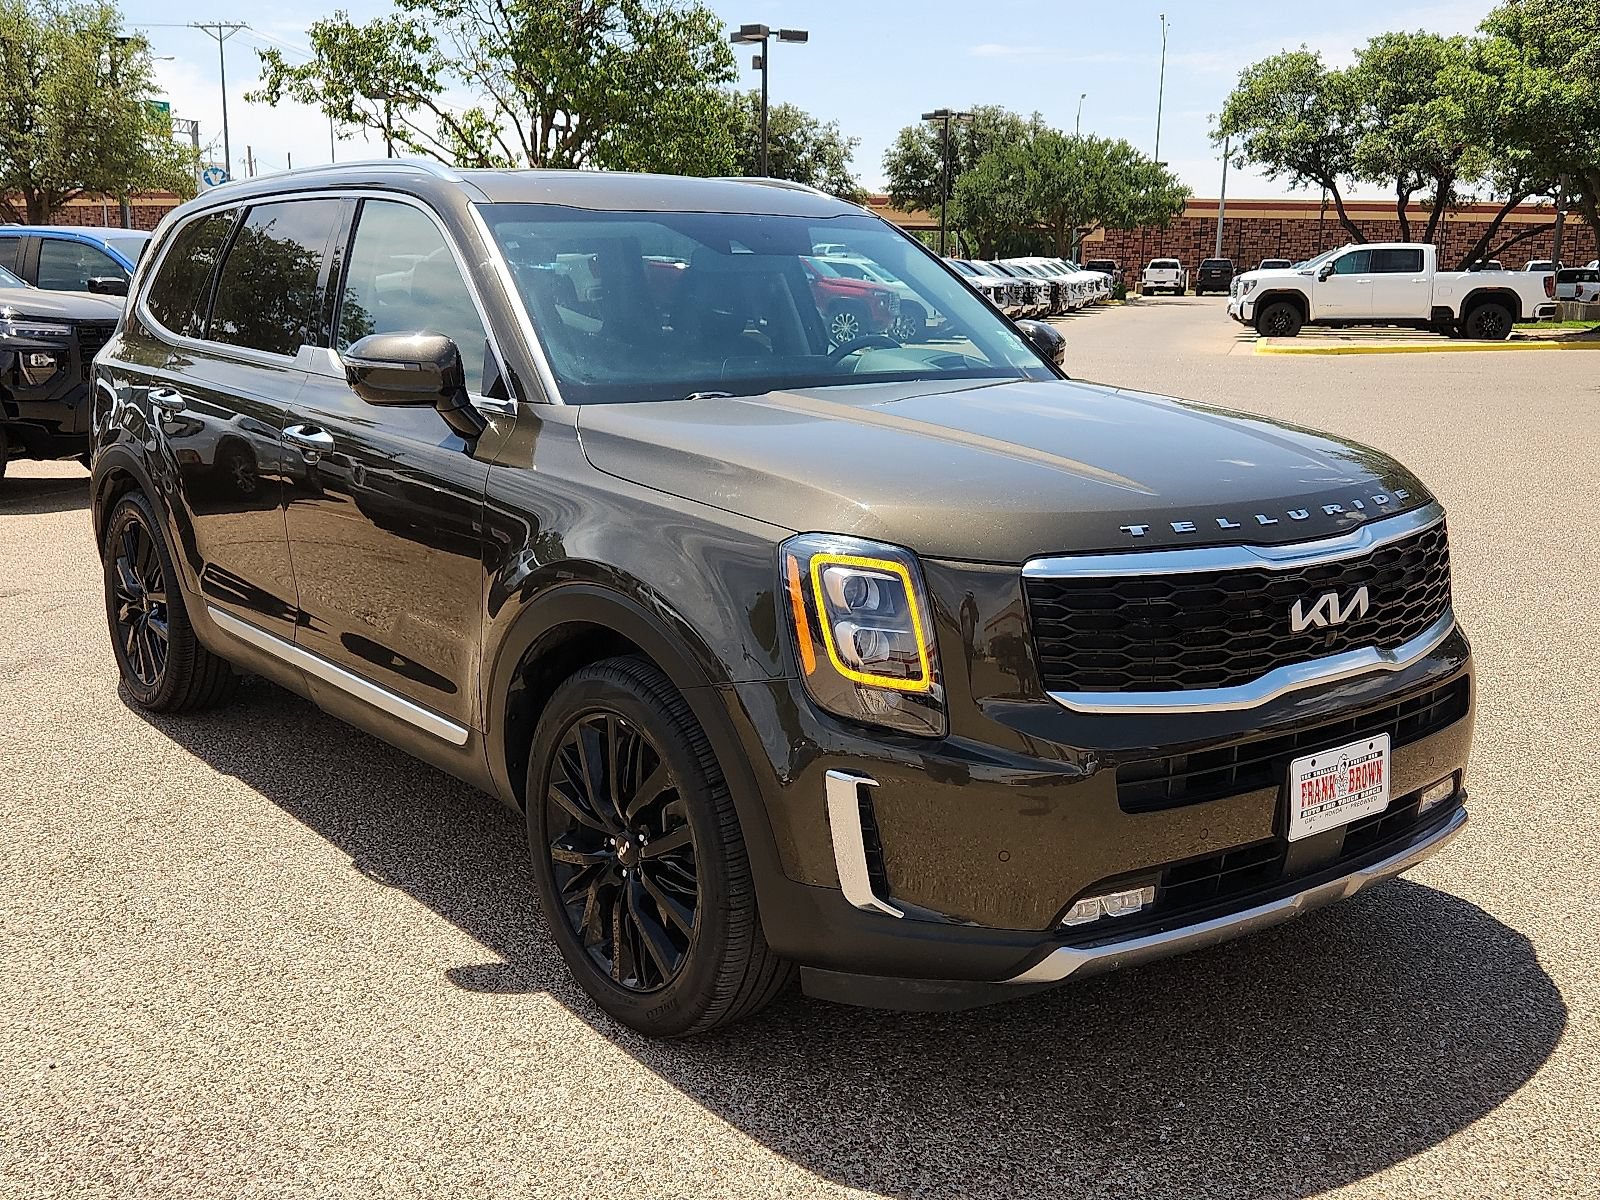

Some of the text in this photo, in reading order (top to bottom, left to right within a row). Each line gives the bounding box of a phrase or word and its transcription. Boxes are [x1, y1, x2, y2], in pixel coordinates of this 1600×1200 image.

[1119, 488, 1410, 537] TELLURIDE
[1290, 586, 1369, 632] KIA
[1301, 759, 1384, 808] FRANK BROWN
[1302, 786, 1381, 818] AUTO AND TRUCK RANCH
[1304, 796, 1378, 825] GMC HONDA PREOWNED
